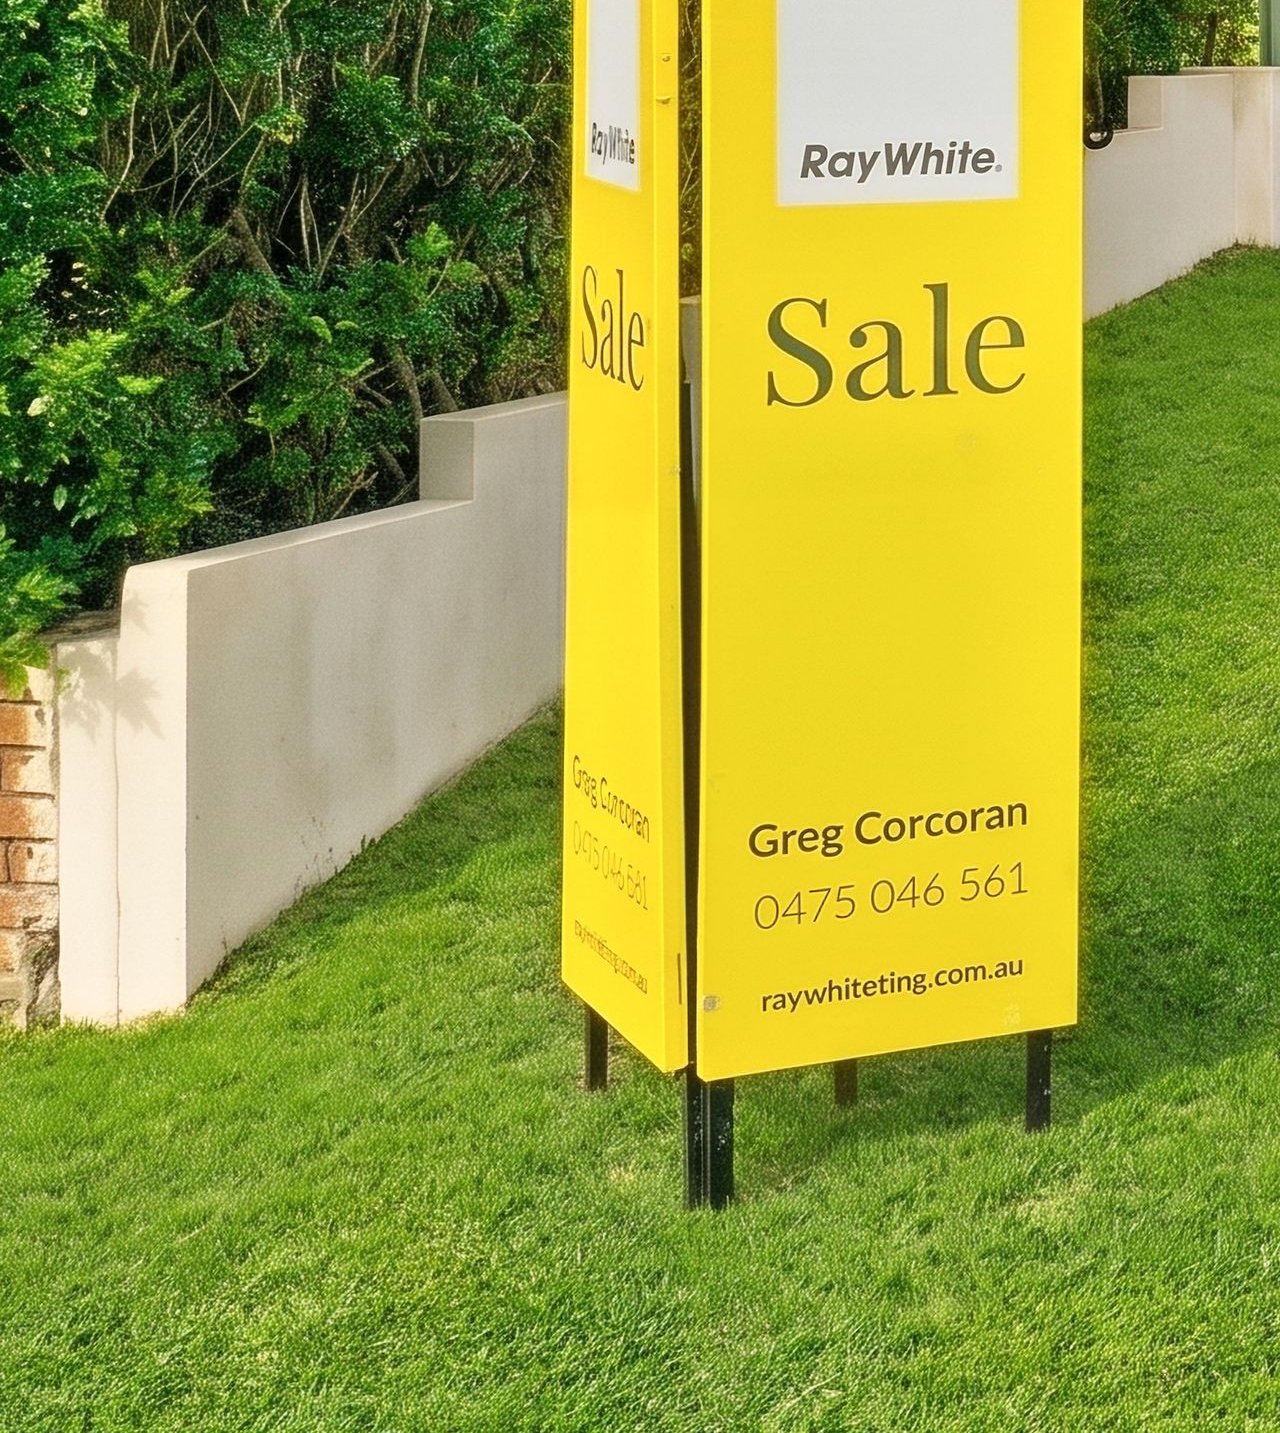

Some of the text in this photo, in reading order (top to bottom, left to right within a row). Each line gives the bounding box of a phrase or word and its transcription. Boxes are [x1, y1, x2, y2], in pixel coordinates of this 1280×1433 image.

[582, 265, 645, 392] Sale
[767, 282, 1026, 407] Sale
[748, 802, 1028, 858] Greg Corcoran
[754, 862, 1029, 930] 0475 046 561
[762, 959, 1024, 1014] raywhiteting.com.au
